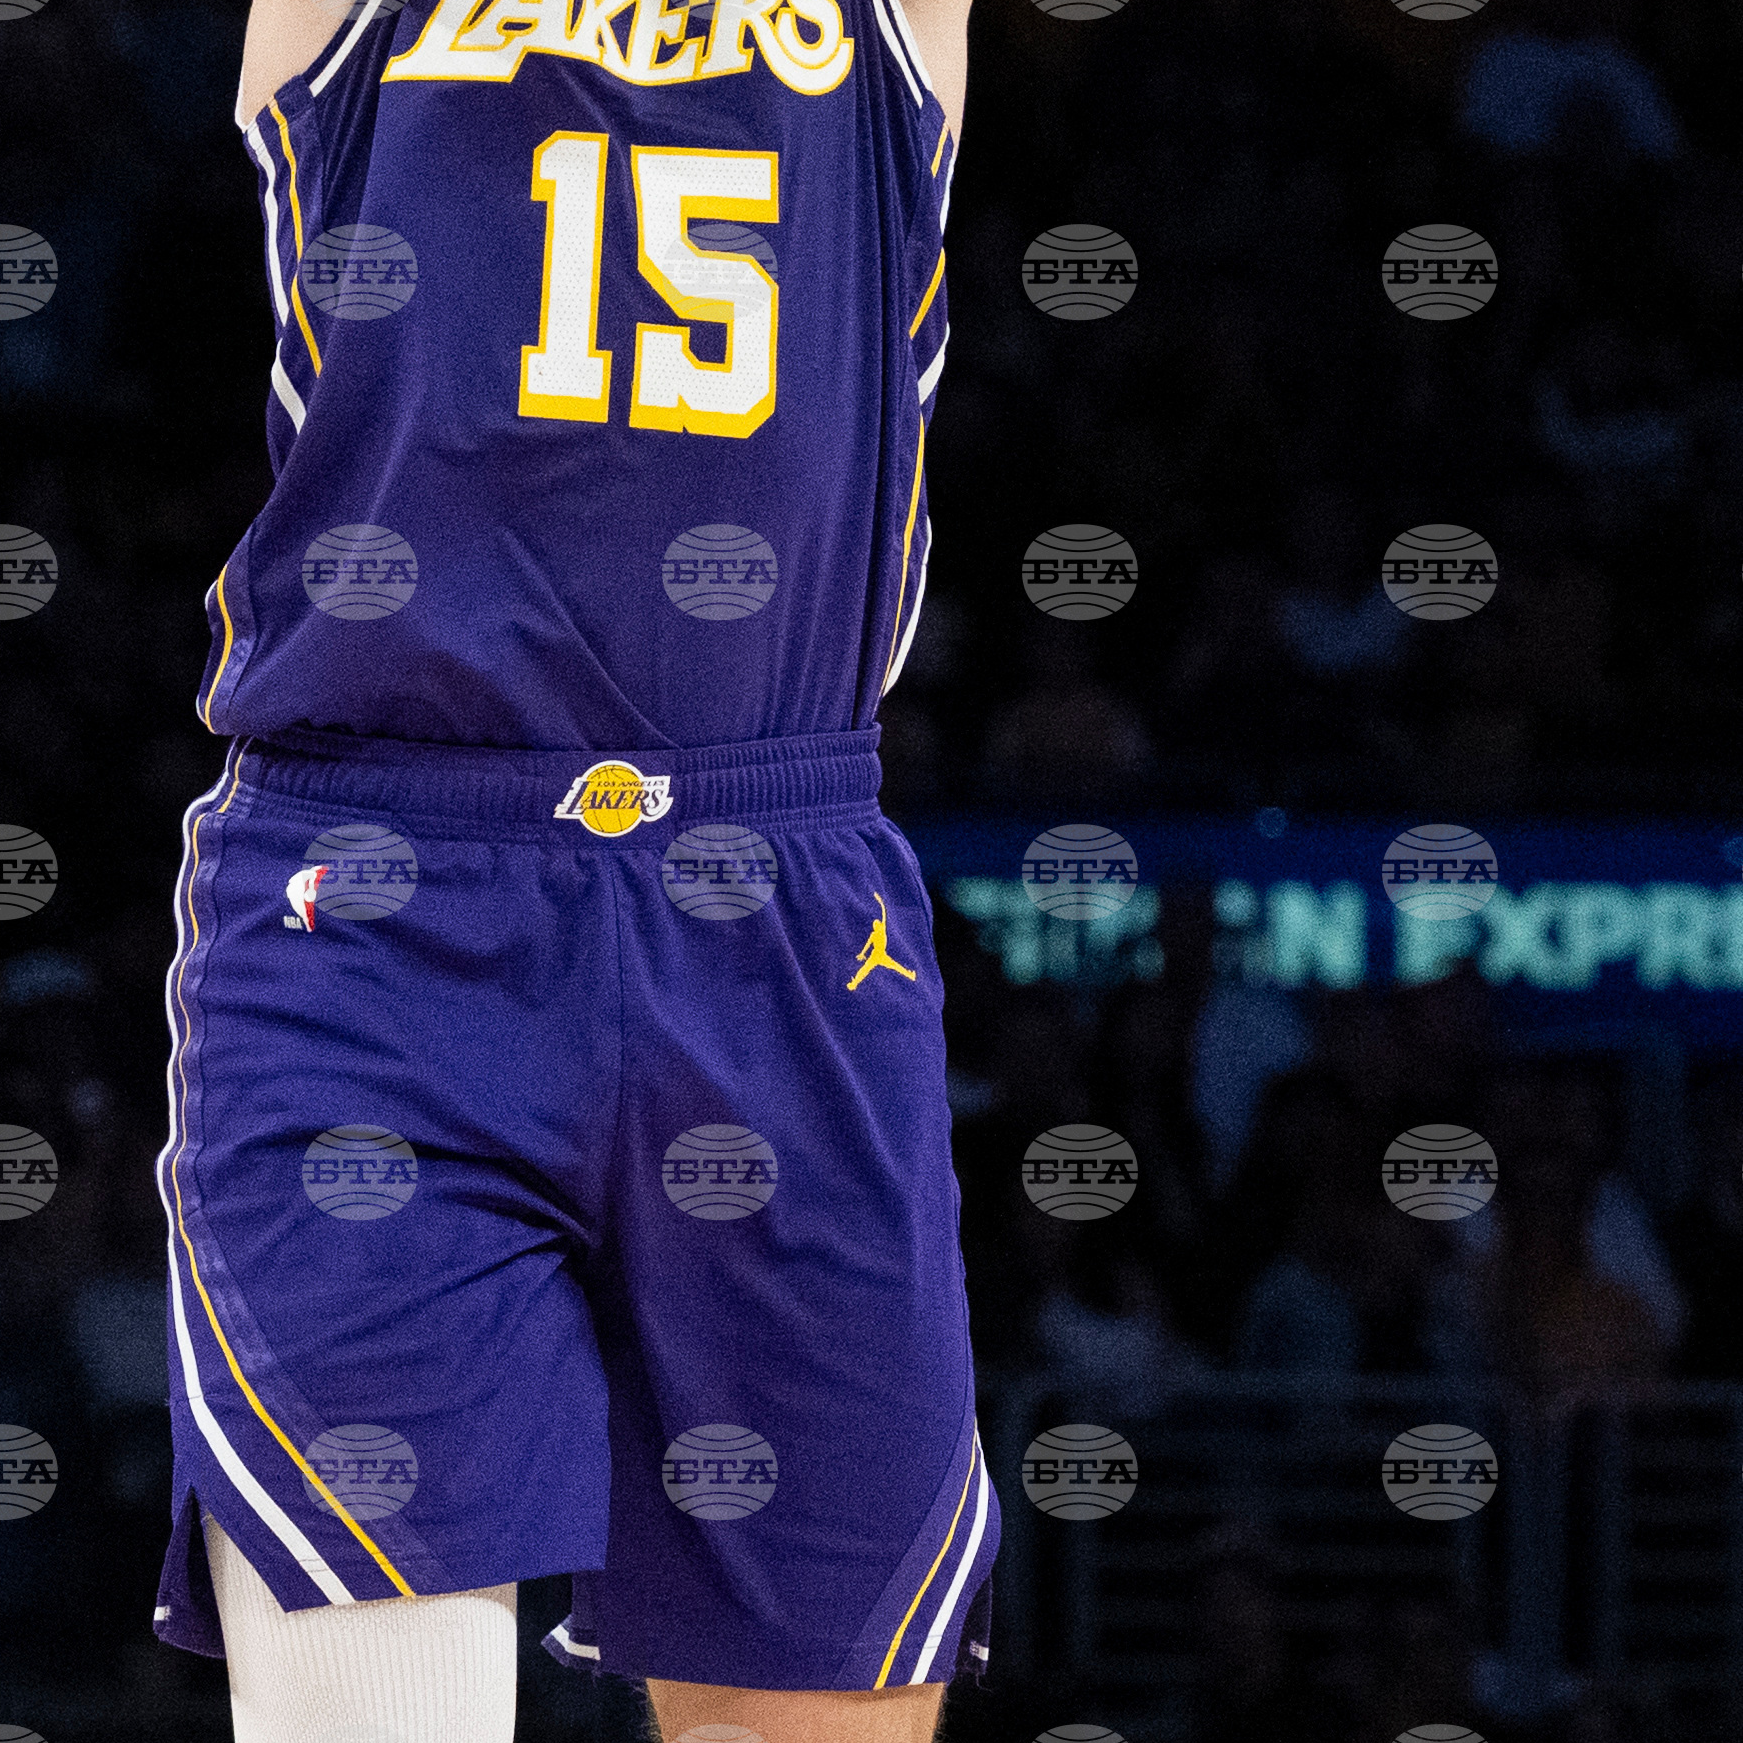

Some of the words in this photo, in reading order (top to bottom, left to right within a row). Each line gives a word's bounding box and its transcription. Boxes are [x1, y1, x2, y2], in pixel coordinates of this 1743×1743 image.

[518, 130, 780, 440] 15
[560, 779, 668, 818] LAKERS
[597, 780, 617, 788] LOS
[617, 779, 665, 788] ANGELES
[283, 915, 303, 930] NBA
[1394, 880, 1743, 992] EXPR
